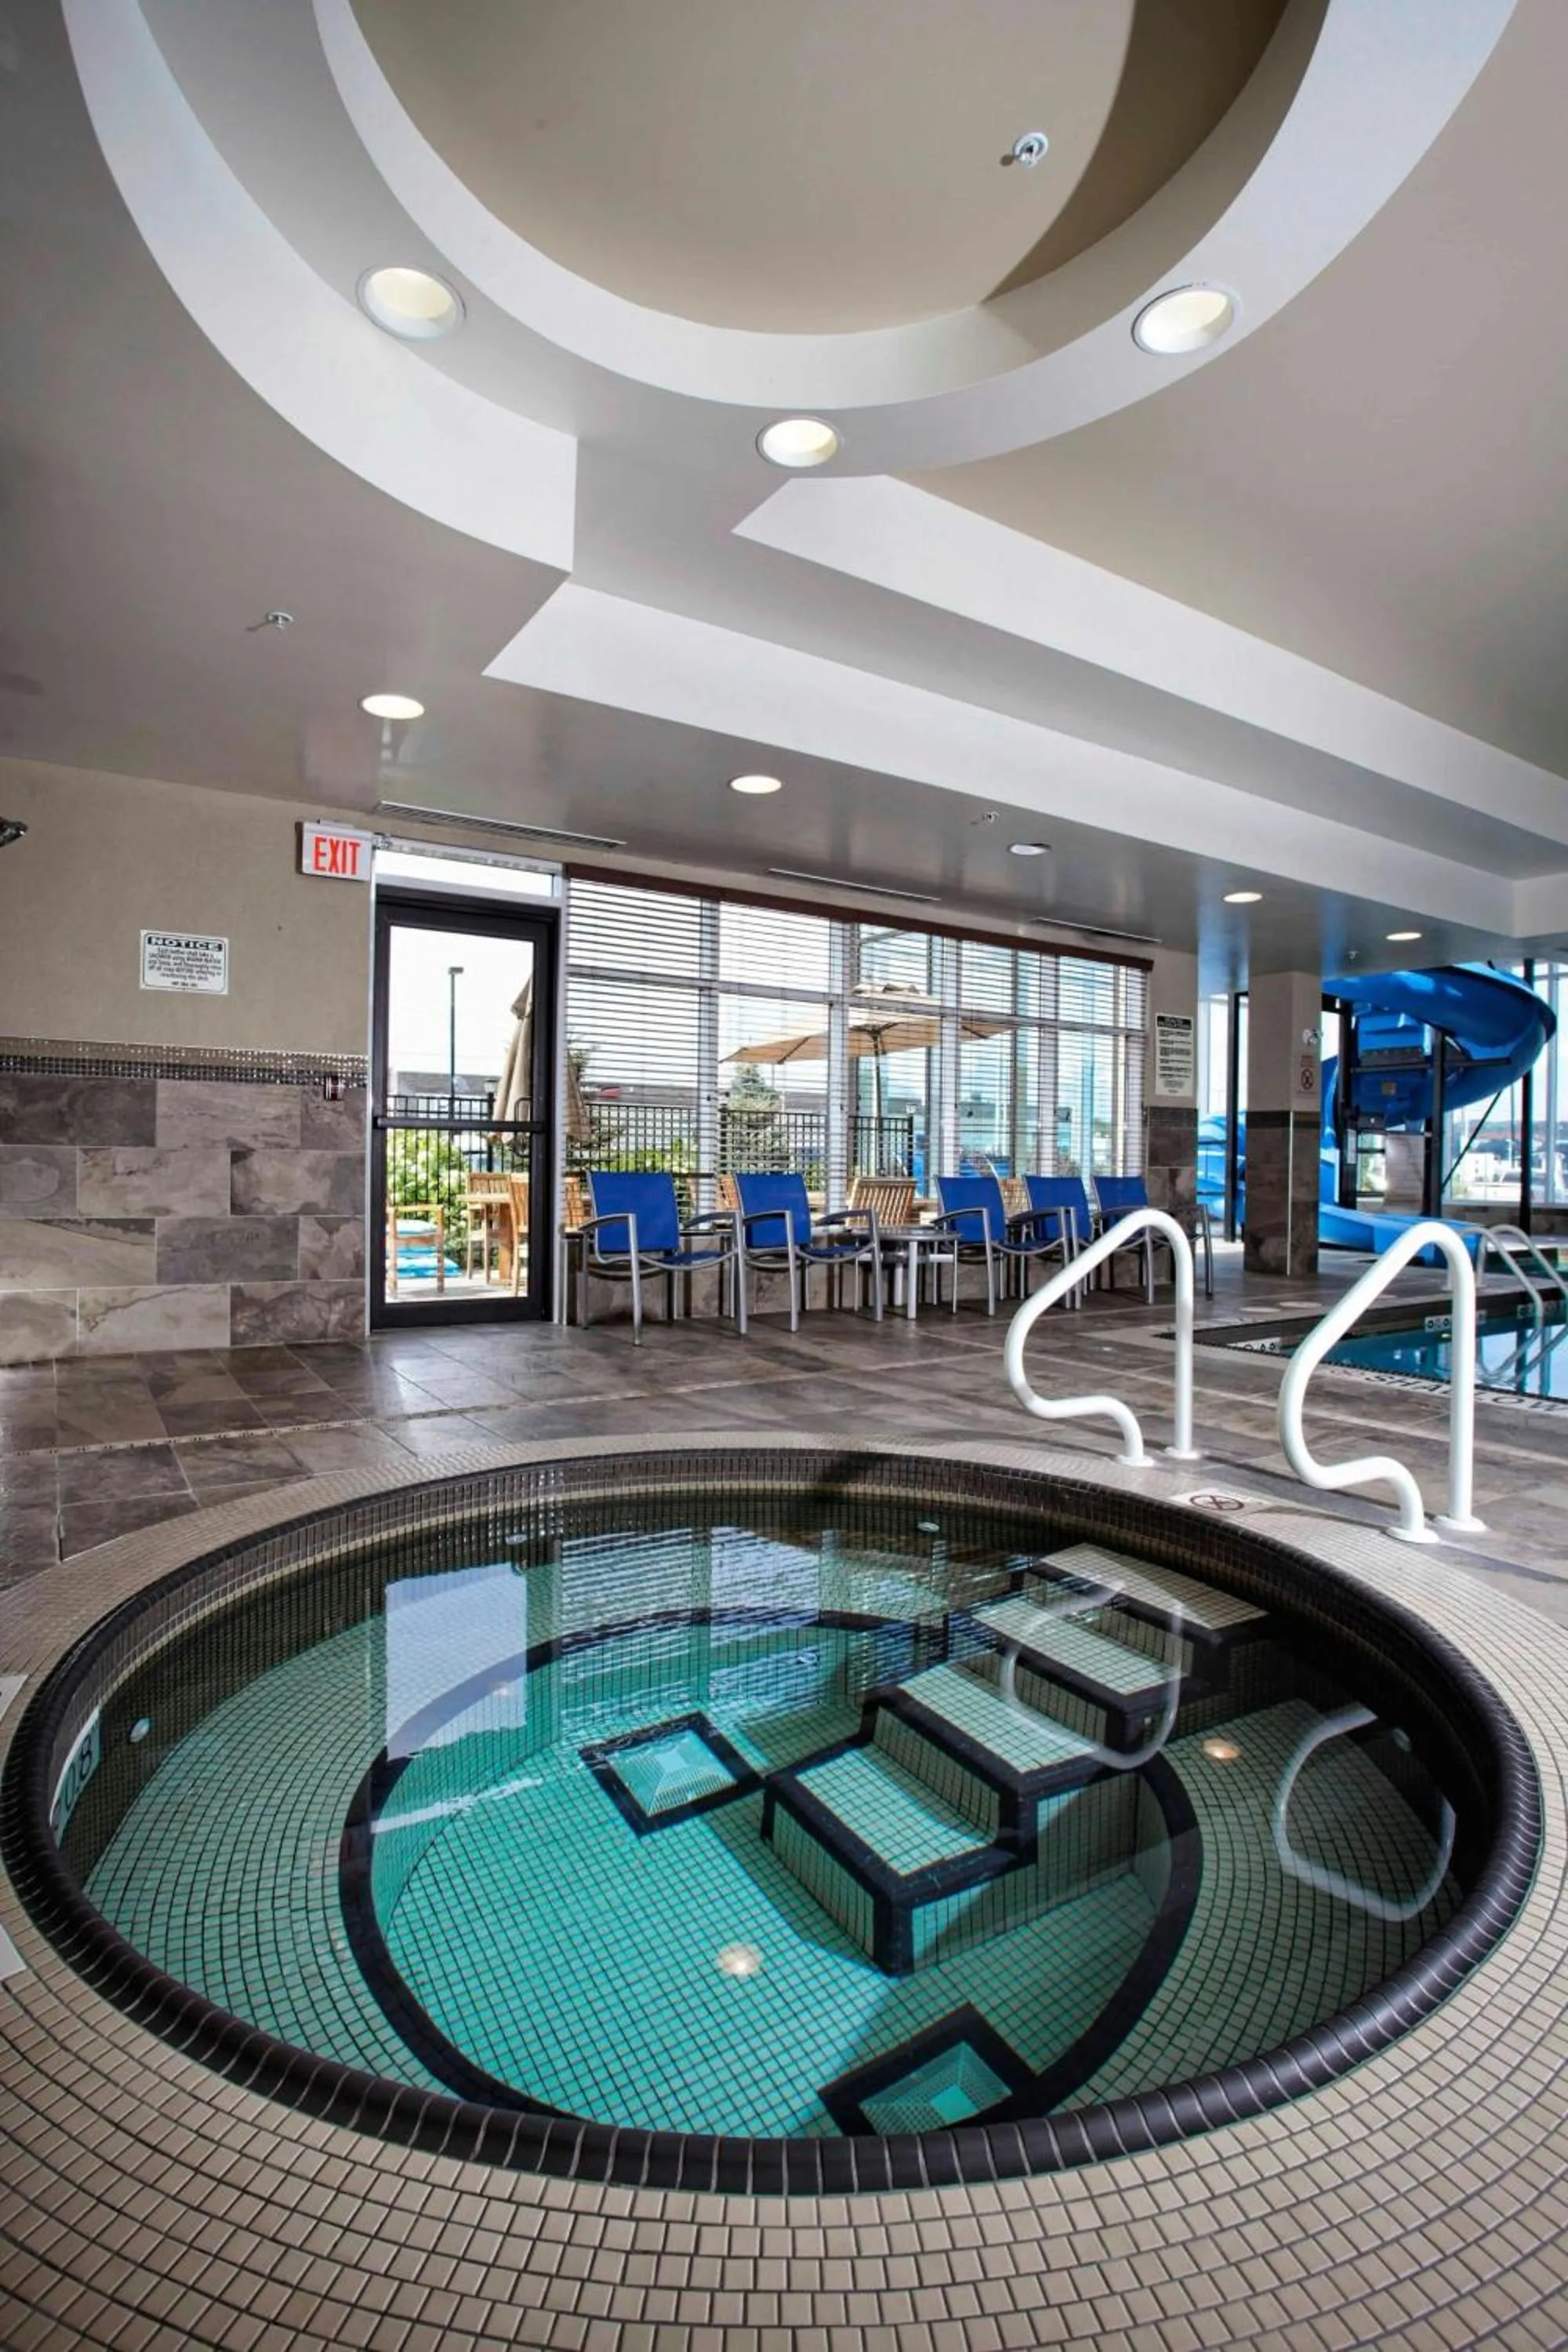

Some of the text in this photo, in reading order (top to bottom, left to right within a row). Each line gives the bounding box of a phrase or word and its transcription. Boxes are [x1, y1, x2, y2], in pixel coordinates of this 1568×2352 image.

[314, 836, 361, 875] EXIT
[150, 937, 220, 951] NOTICE
[1364, 1374, 1566, 1411] SHAOW
